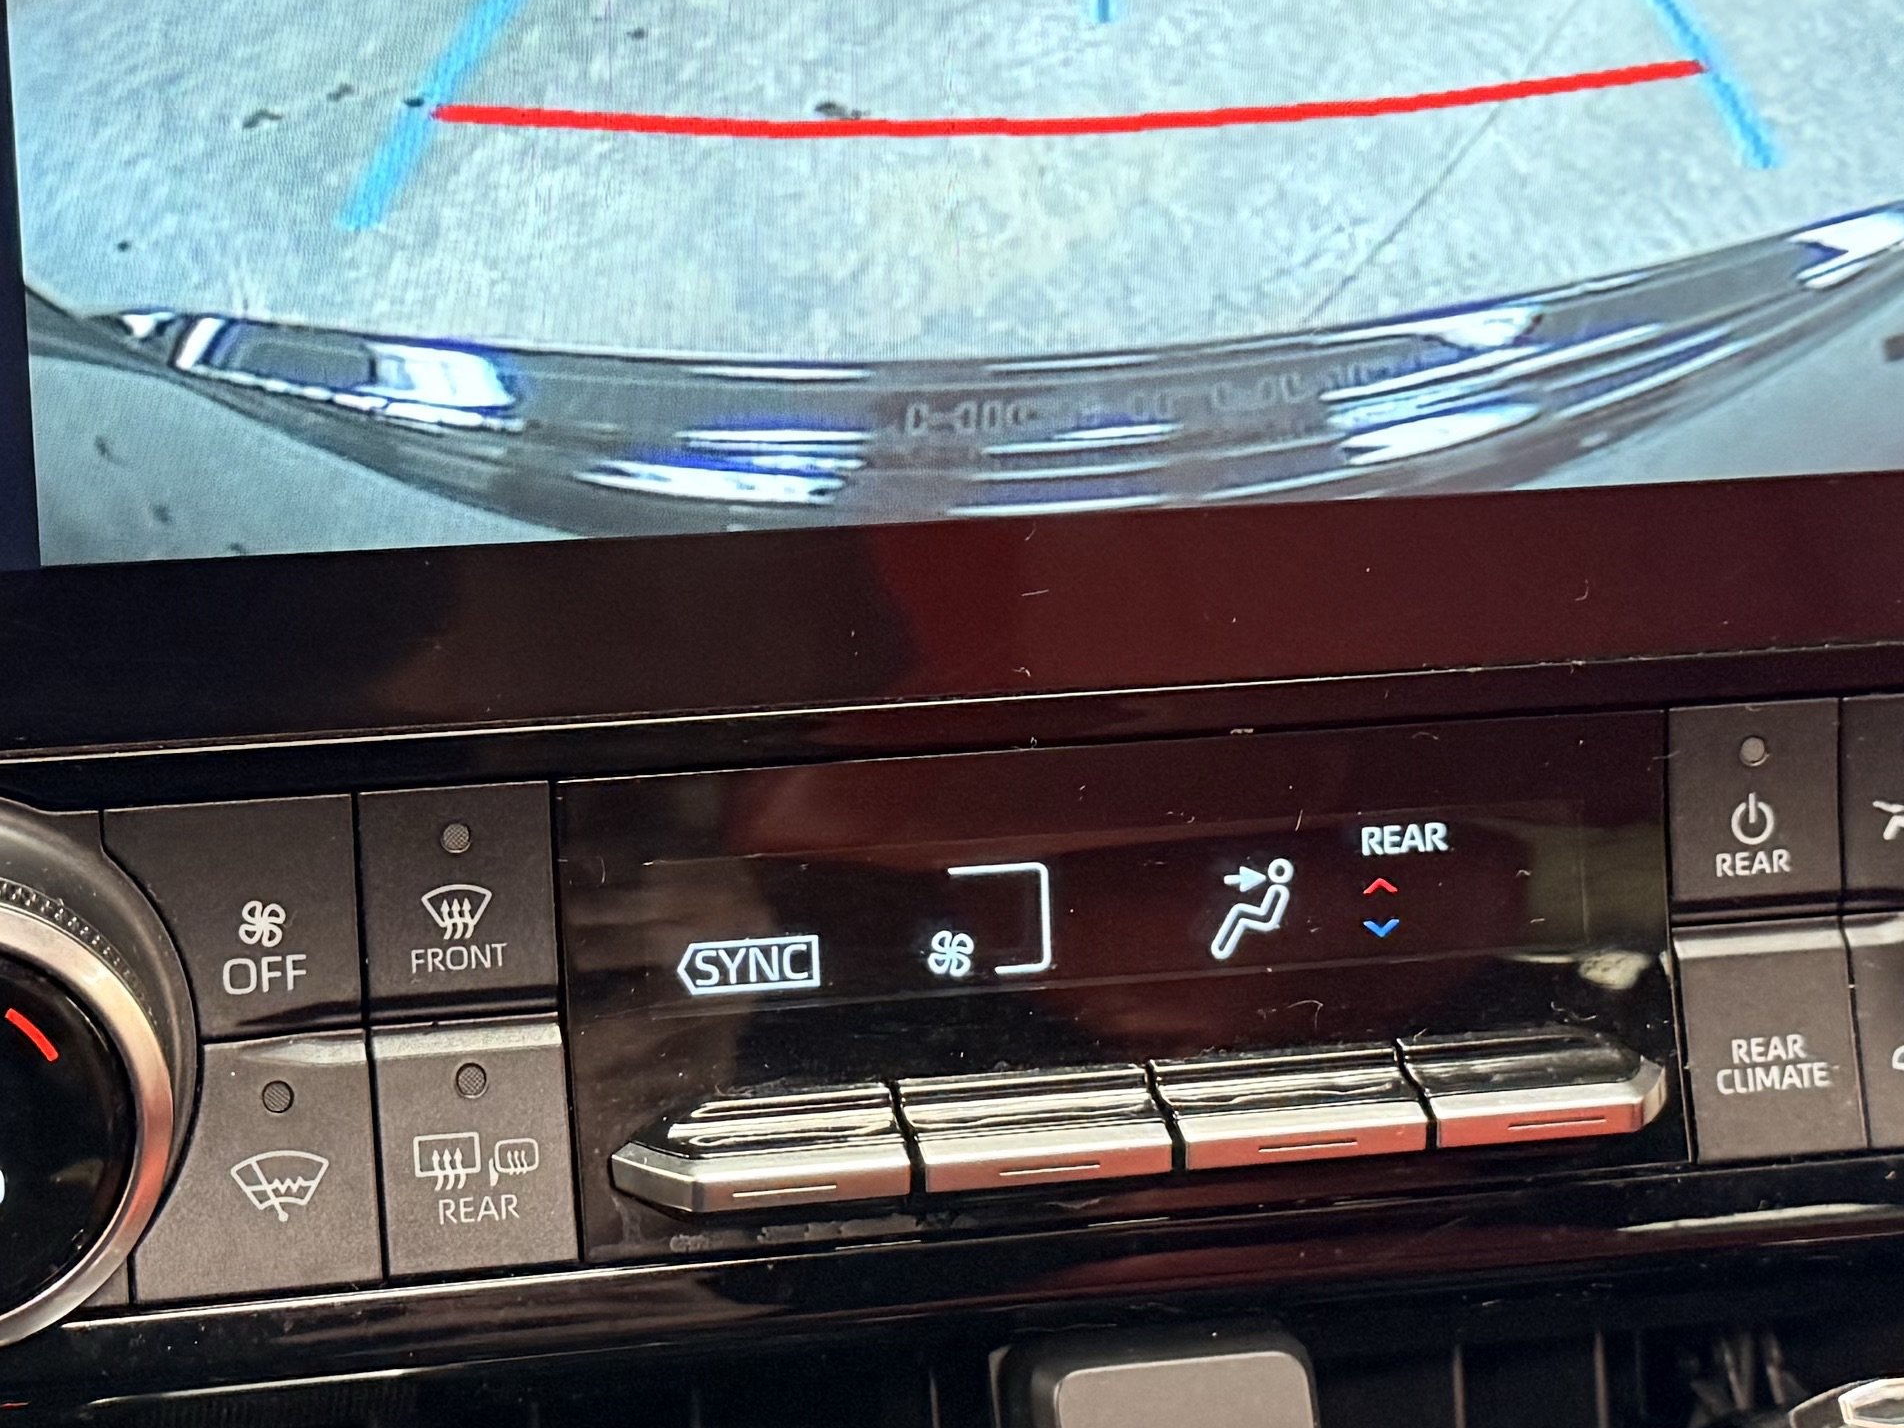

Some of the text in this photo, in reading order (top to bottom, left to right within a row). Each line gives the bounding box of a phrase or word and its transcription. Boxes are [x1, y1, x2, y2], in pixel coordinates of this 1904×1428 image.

[1360, 822, 1448, 857] REAR
[1716, 849, 1791, 877] REAR
[410, 942, 507, 974] FRONT
[694, 943, 810, 986] SYNC
[223, 954, 307, 995] OFF
[1732, 1034, 1807, 1063] REAR
[1716, 1062, 1830, 1095] CLIMATE
[438, 1194, 520, 1225] REAR
